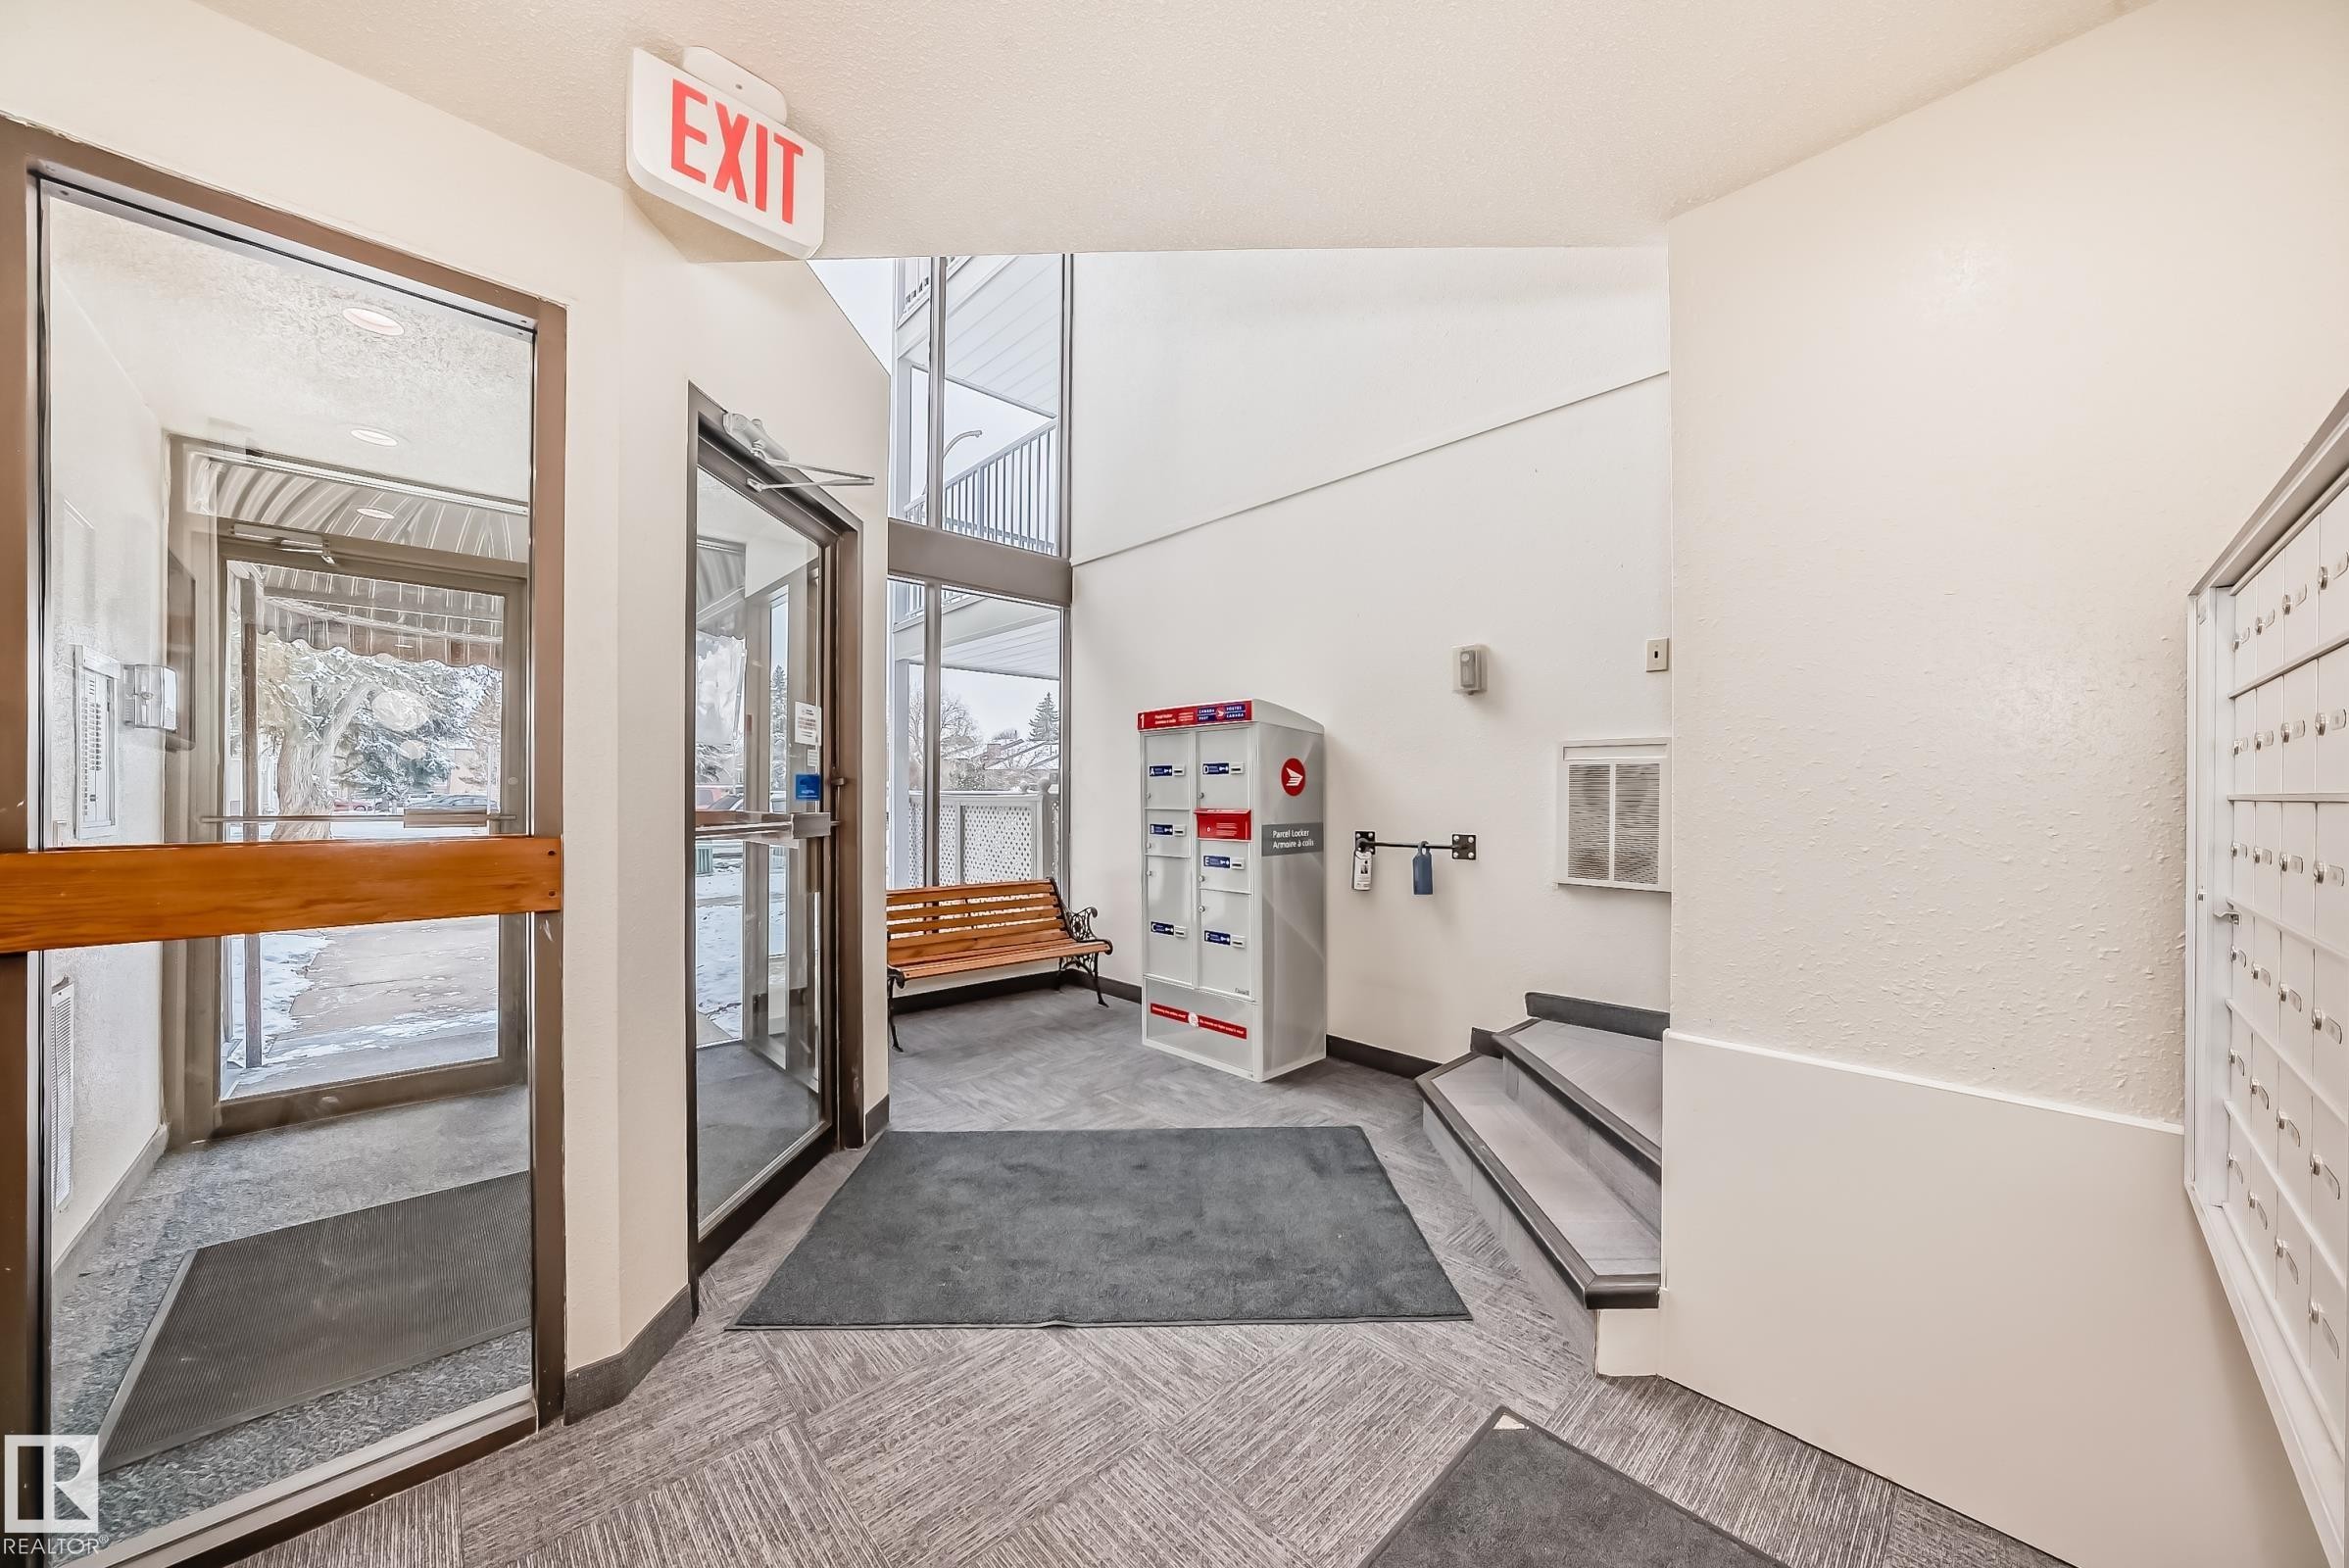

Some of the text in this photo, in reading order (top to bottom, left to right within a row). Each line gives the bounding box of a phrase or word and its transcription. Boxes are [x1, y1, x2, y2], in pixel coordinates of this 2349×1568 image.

[671, 77, 804, 225] EXIT
[1140, 713, 1145, 729] 1
[1150, 766, 1155, 775] A
[1202, 764, 1209, 774] D
[1272, 829, 1310, 839] Parcel Locker
[1272, 840, 1297, 850] Armoire
[1205, 932, 1210, 941] F
